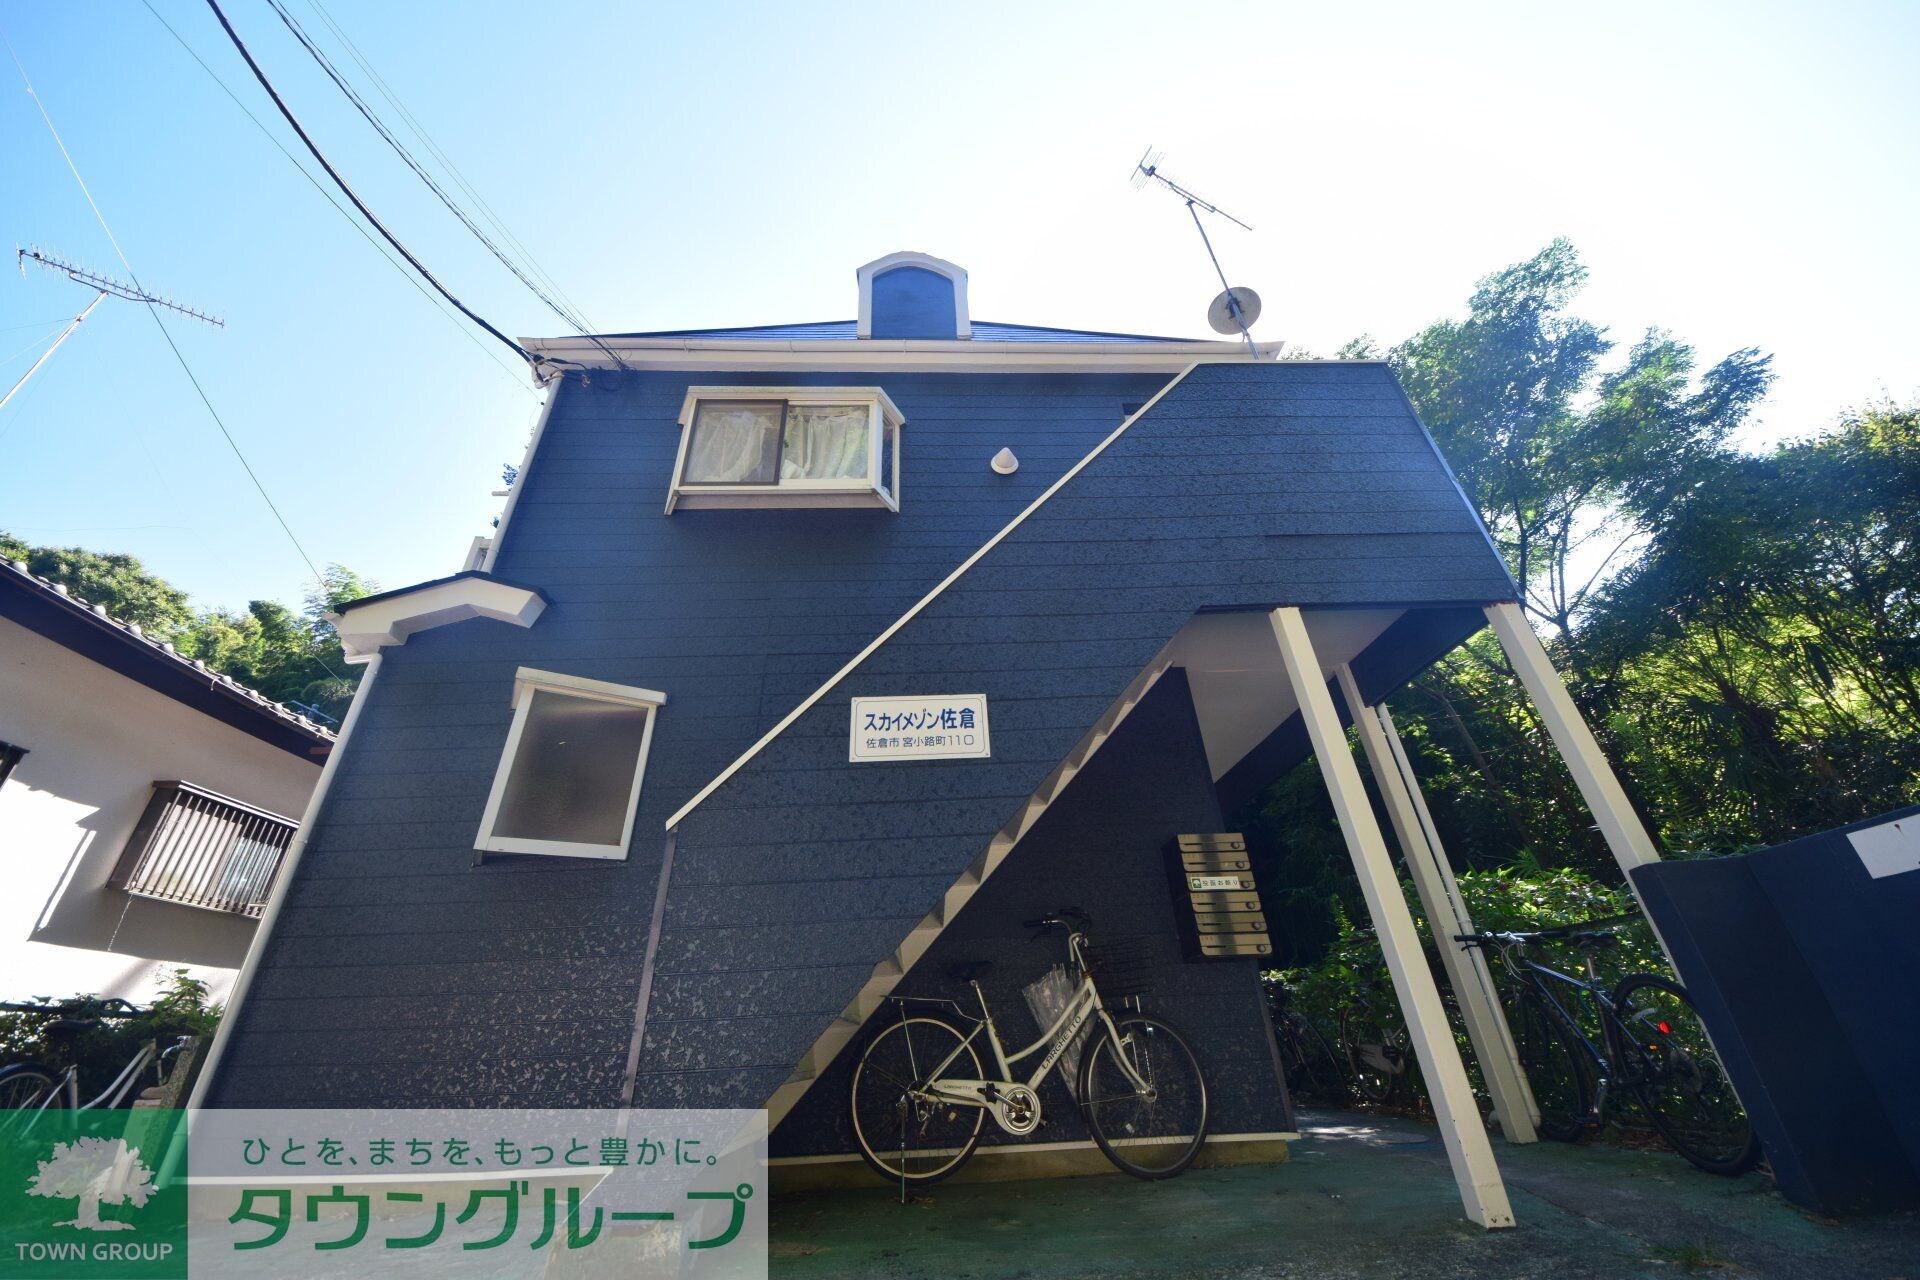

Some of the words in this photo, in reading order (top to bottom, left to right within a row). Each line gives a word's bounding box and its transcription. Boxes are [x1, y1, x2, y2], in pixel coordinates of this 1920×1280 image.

[864, 707, 975, 731] スカイメゾン佐倉
[1041, 1015, 1082, 1070] LARGHETTO
